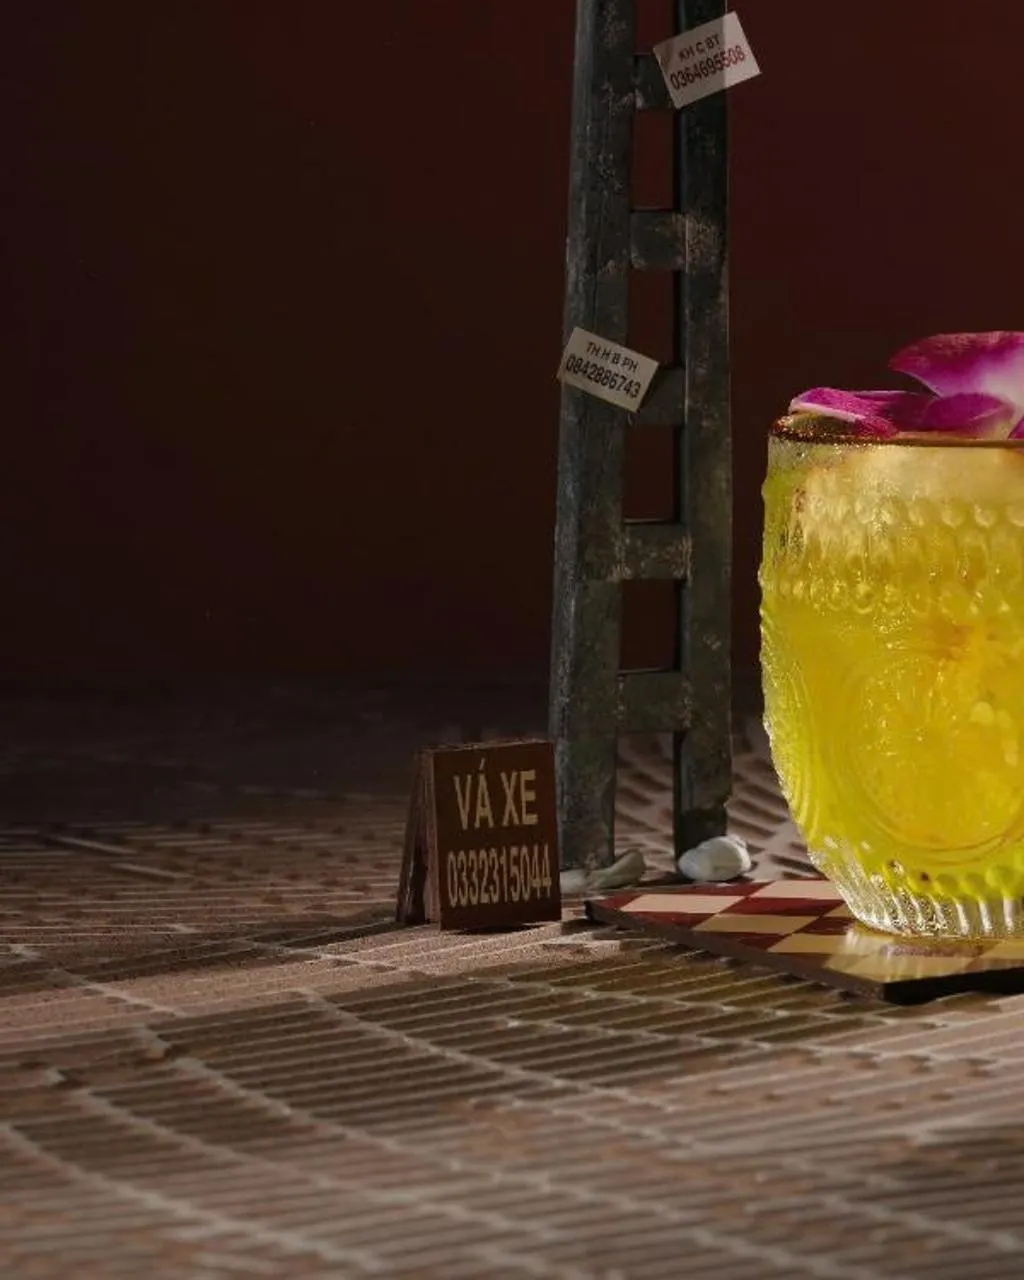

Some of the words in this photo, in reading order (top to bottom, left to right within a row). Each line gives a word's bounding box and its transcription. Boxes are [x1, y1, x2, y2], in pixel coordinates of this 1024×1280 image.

[705, 34, 721, 50] BT
[586, 342, 600, 357] TH
[600, 349, 611, 361] H
[611, 353, 621, 365] B
[621, 357, 639, 372] PH
[453, 757, 495, 830] VÁ
[500, 769, 539, 827] XE
[447, 843, 553, 908] 0332315044
